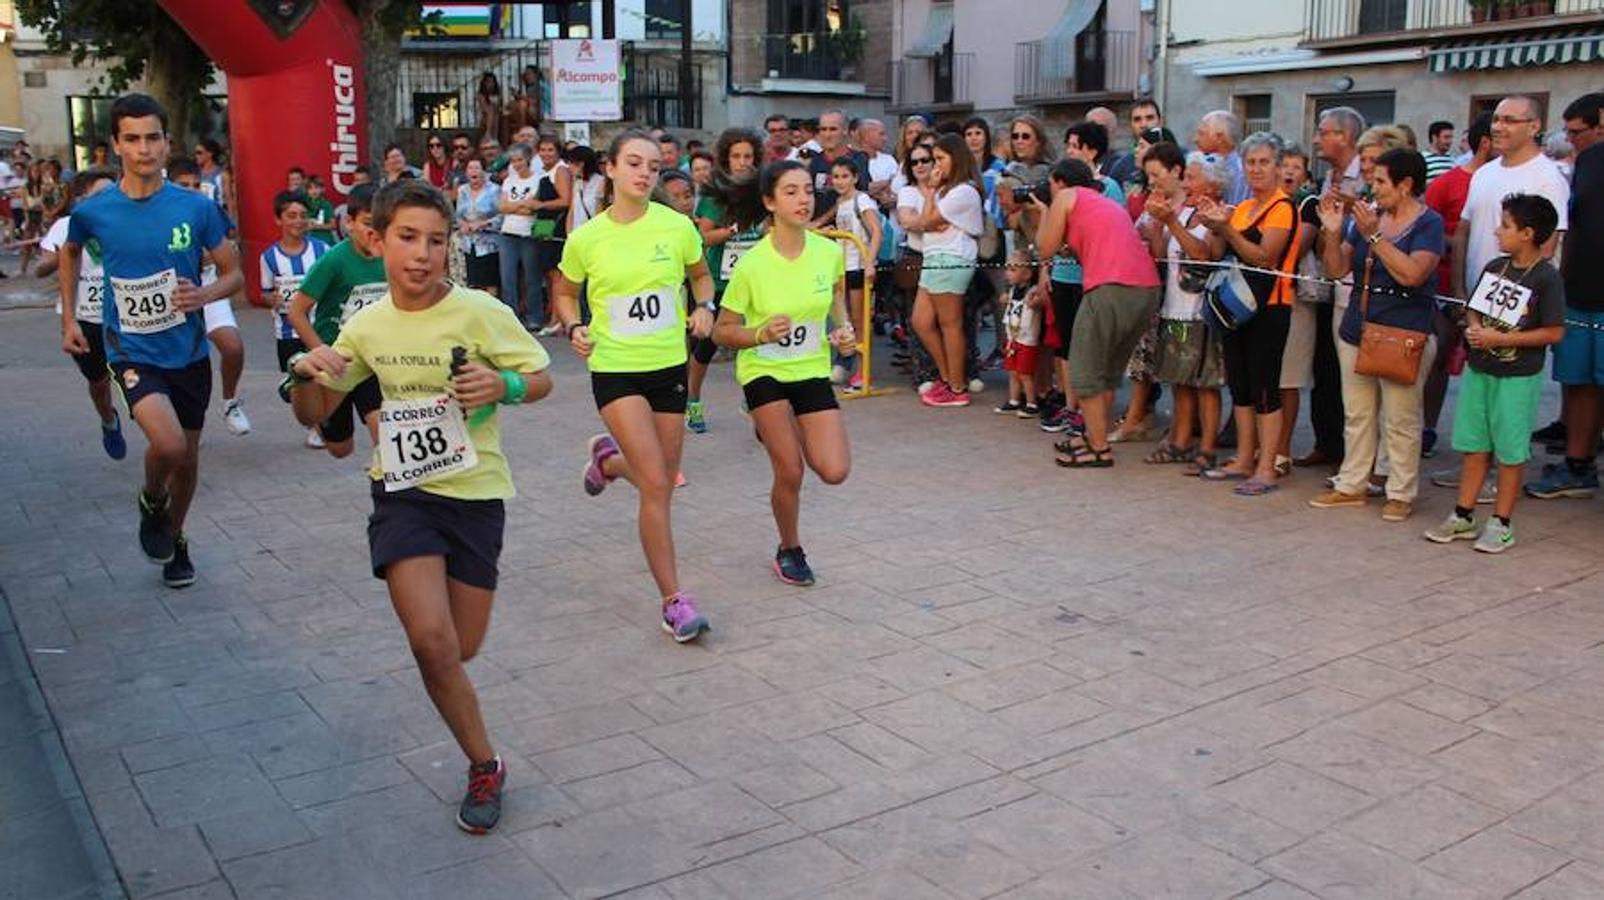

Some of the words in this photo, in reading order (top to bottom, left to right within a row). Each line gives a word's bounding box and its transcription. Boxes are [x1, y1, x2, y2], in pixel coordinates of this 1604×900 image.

[330, 64, 358, 195] Chiruca
[125, 293, 167, 317] 249
[628, 294, 661, 321] 40
[1485, 281, 1523, 311] 255
[400, 355, 441, 367] POPULAR
[380, 409, 390, 422] EL
[392, 405, 446, 422] CORREO
[391, 426, 448, 464] 138
[384, 470, 401, 483] EL
[402, 453, 463, 480] CORREO
